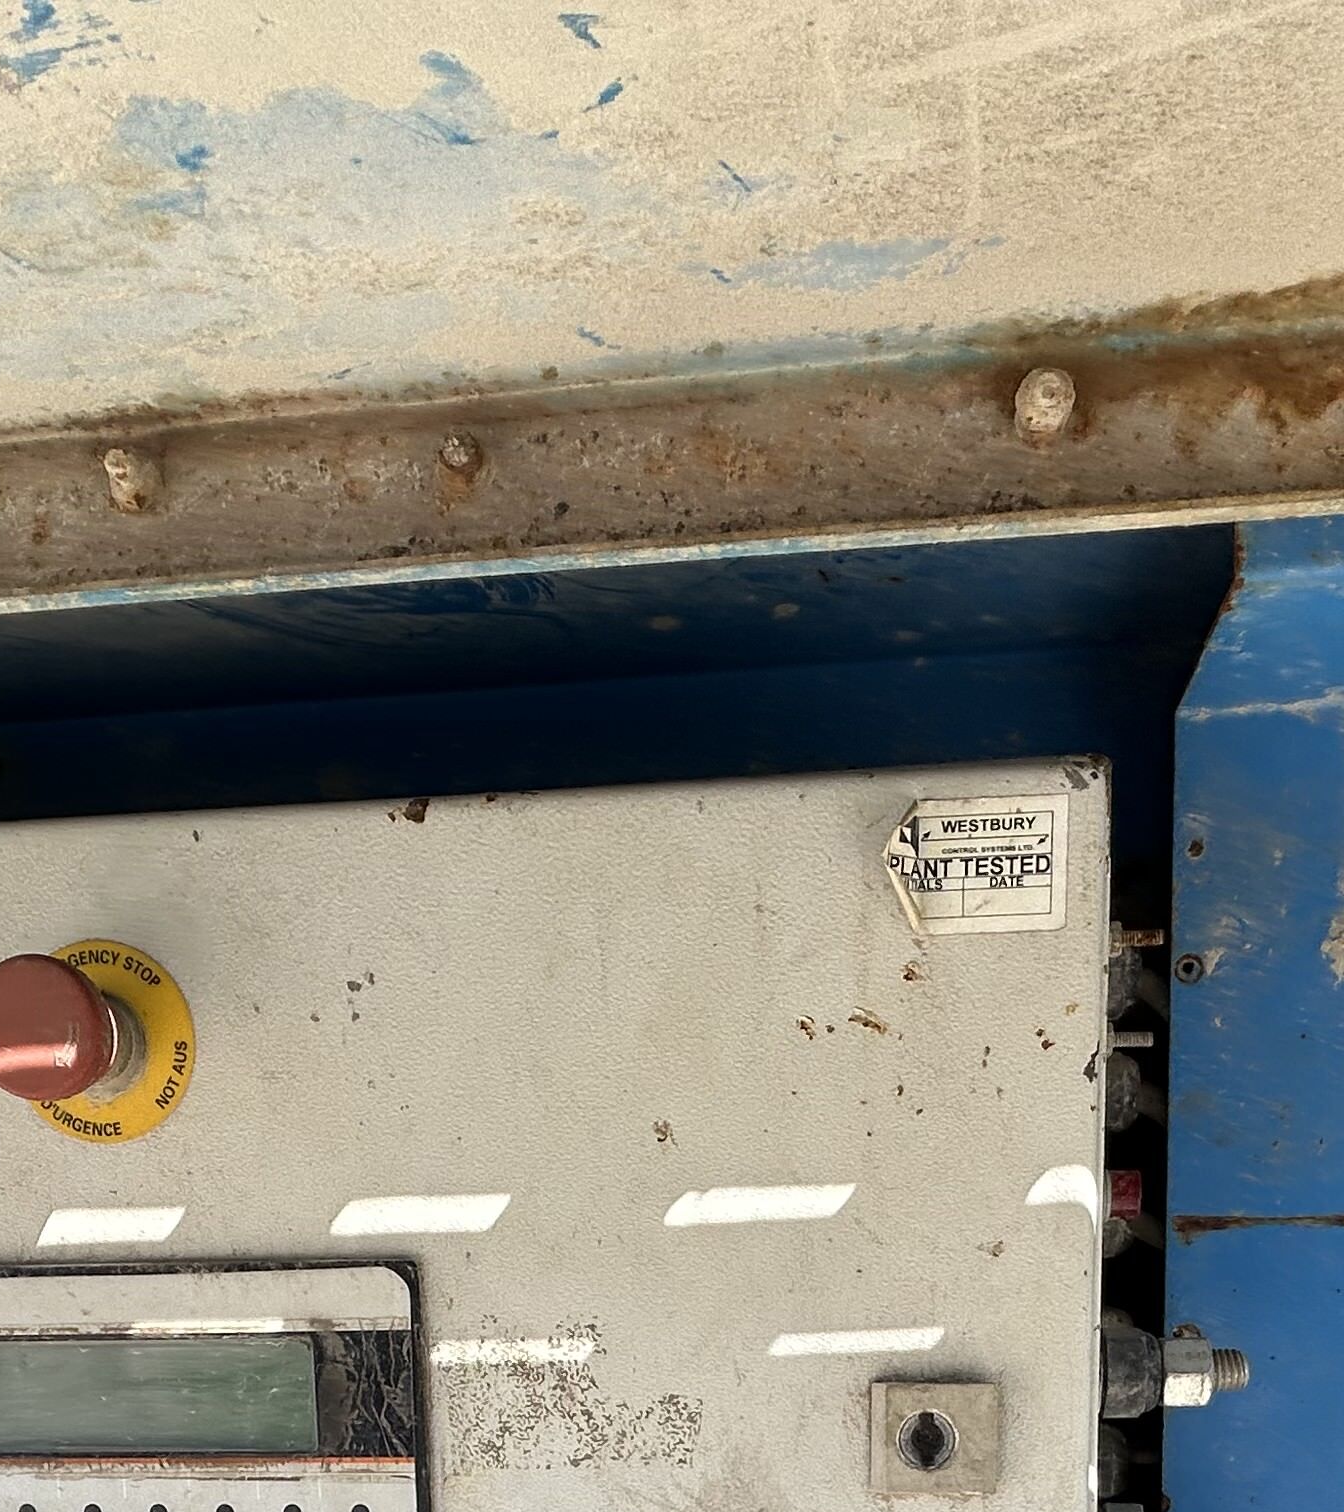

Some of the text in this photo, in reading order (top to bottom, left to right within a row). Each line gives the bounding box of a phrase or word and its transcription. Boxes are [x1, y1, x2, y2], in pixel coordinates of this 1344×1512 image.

[941, 816, 1036, 834] WESTBURY
[942, 847, 979, 855] CONTROL
[981, 845, 1016, 854] SYSTEMS
[890, 855, 1050, 879] PLANT TESTED
[989, 876, 1025, 888] DATE
[66, 949, 162, 987] GENCY STOP
[154, 1041, 188, 1110] NOT AUS
